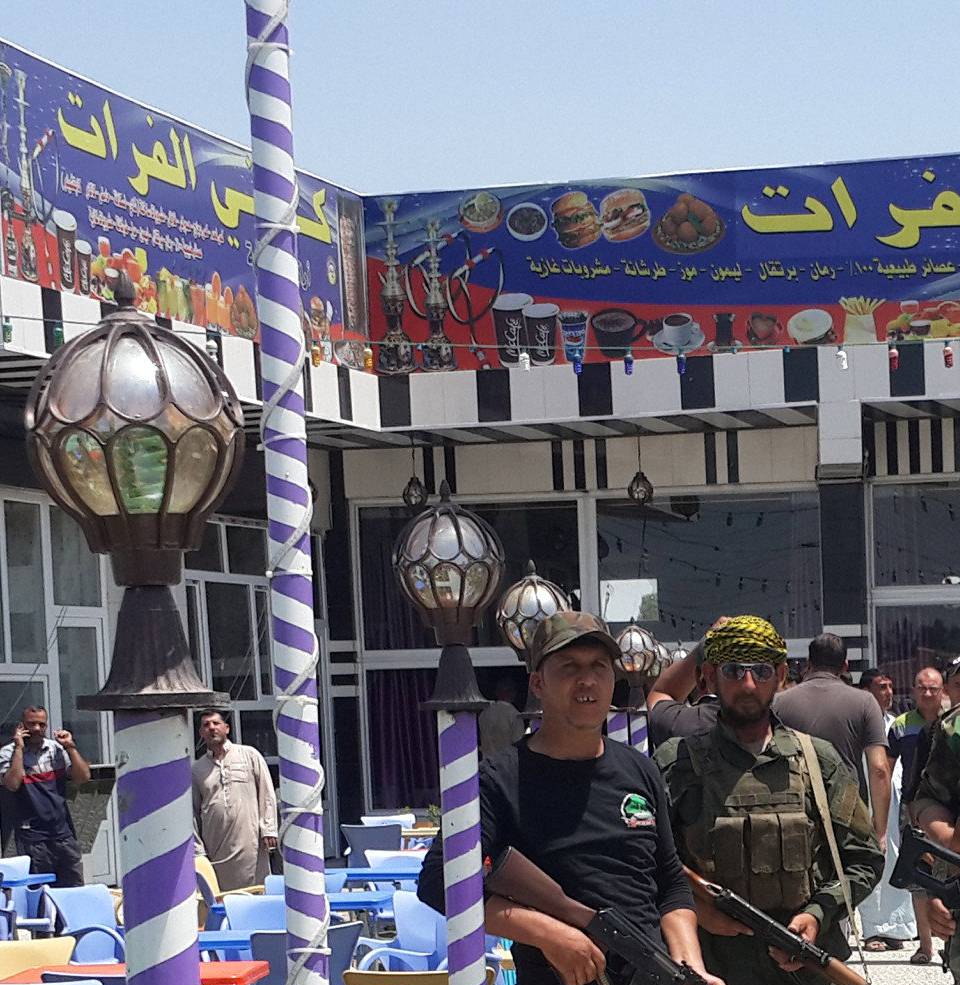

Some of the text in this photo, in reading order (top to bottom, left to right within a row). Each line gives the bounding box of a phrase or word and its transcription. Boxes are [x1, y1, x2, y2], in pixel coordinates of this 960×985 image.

[57, 91, 198, 196] الفرات
[677, 261, 698, 281] موز
[711, 261, 744, 282] ليمون
[759, 260, 799, 283] برتقال
[810, 261, 837, 282] رمان
